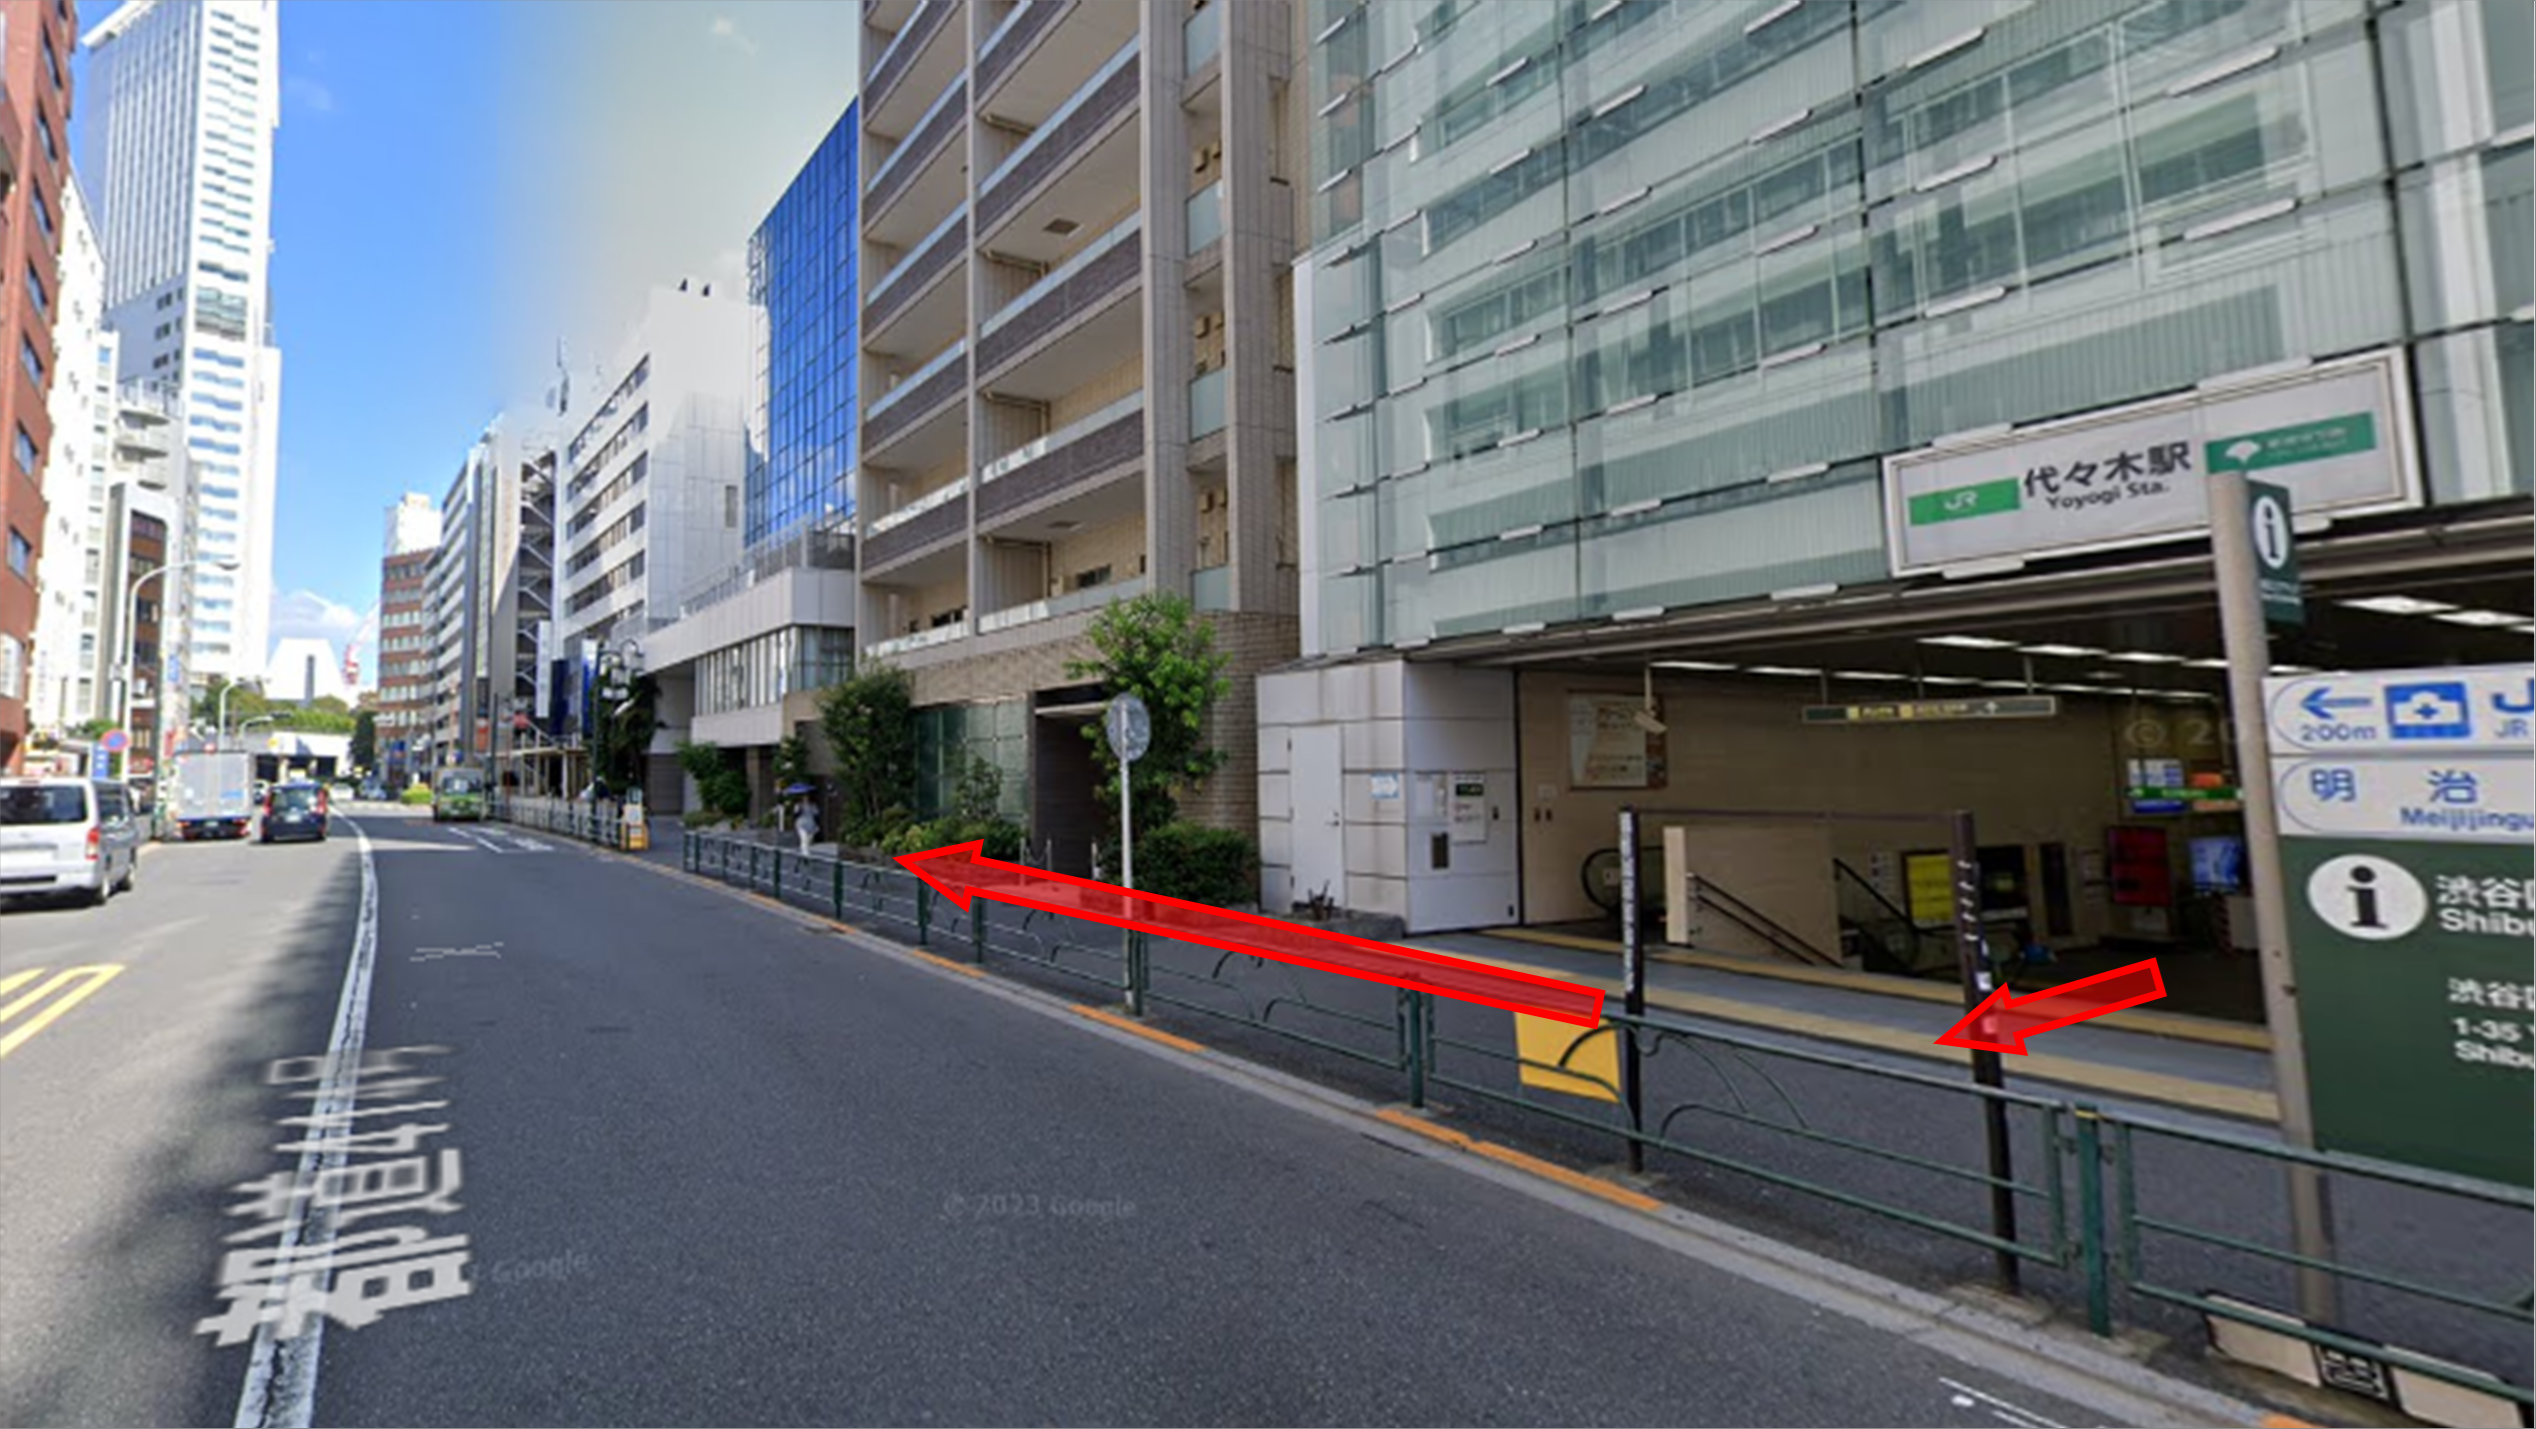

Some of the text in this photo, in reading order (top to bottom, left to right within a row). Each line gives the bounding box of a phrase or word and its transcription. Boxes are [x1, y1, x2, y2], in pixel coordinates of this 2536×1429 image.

[2024, 440, 2192, 498] 代々木駅
[1943, 490, 1978, 512] JR
[2046, 480, 2170, 510] Yoyogi Sta.
[2301, 724, 2377, 742] 200m
[2495, 718, 2529, 738] JR
[2453, 1017, 2522, 1043] 1-35
